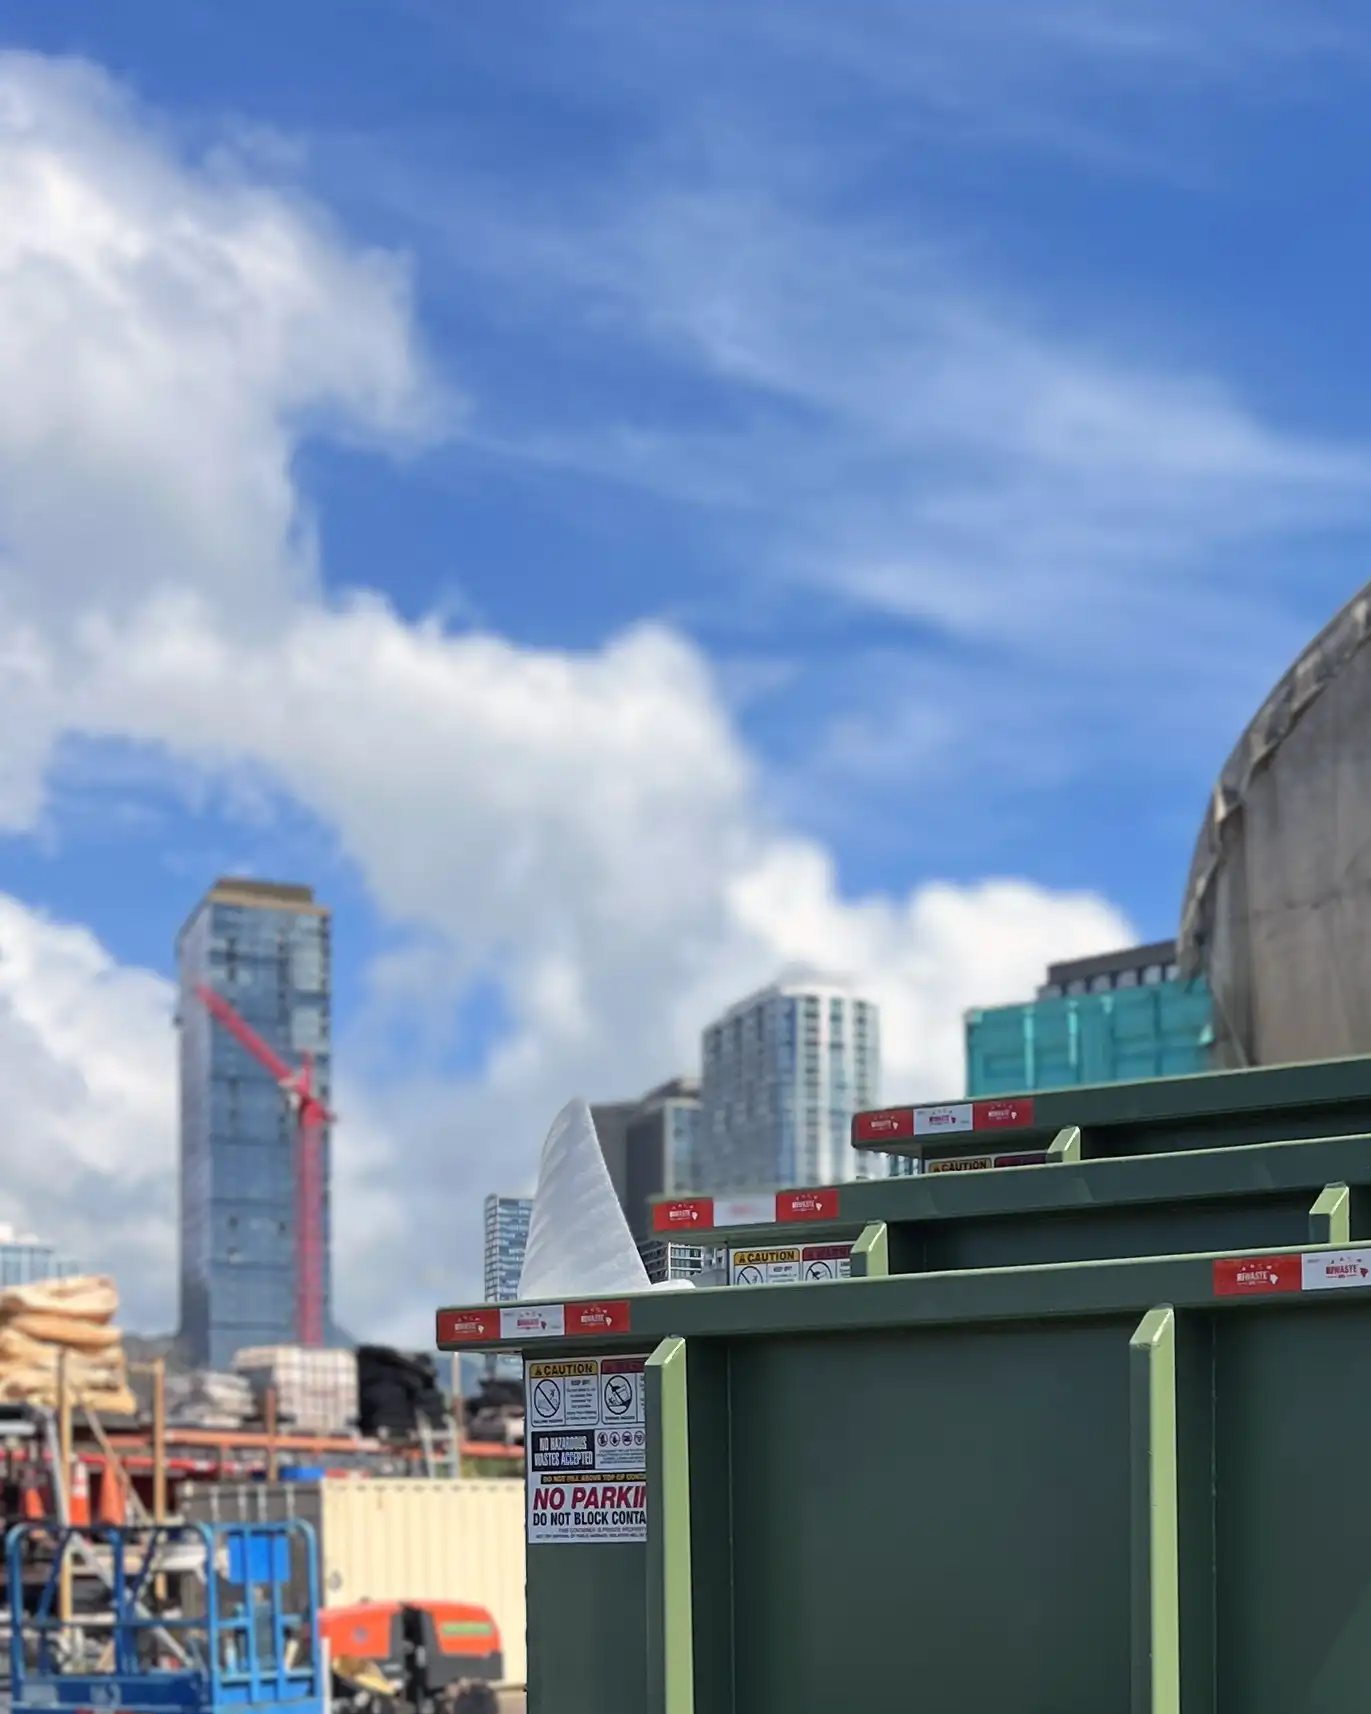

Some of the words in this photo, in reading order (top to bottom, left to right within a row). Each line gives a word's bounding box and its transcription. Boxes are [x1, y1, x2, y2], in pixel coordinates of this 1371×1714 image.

[941, 1160, 987, 1171] CAUTION
[747, 1251, 794, 1264] CAUTION
[543, 1362, 592, 1375] CAUTION
[539, 1437, 548, 1451] NO
[534, 1451, 559, 1466] WASTES
[560, 1450, 592, 1465] ACCEPTED
[532, 1487, 565, 1510] NO
[533, 1512, 546, 1525] DO
[550, 1511, 570, 1525] NOT
[574, 1511, 608, 1525] BLOCK
[611, 1510, 645, 1525] CONTA
